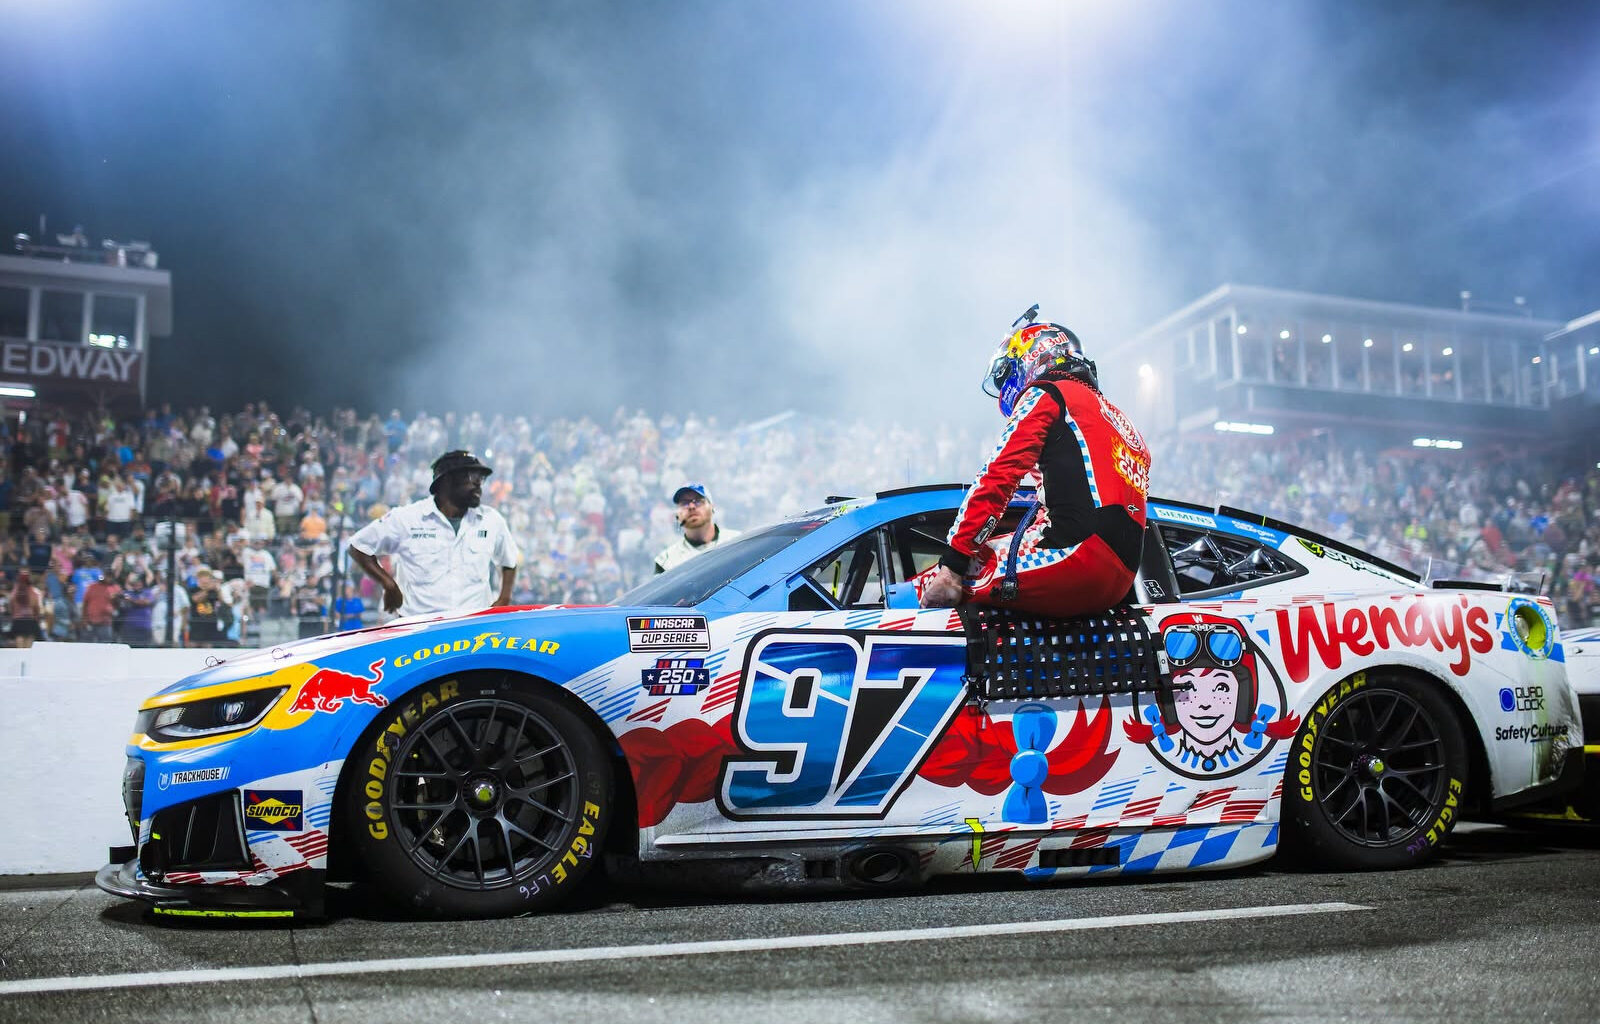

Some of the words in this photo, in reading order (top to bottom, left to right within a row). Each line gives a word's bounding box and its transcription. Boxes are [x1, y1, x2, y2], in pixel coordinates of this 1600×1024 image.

[1022, 342, 1047, 362] Red
[1119, 447, 1136, 469] LET
[1158, 509, 1213, 525] SIEMENS
[653, 618, 695, 629] NASCAR
[641, 633, 662, 644] CUP
[663, 632, 698, 643] SERIES
[1276, 594, 1493, 683] Wendy's
[658, 669, 695, 684] 250
[1515, 686, 1543, 699] QUAD
[1517, 699, 1545, 711] LOCK
[720, 631, 968, 816] 97
[174, 769, 220, 784] TRACKHOUSE
[247, 806, 300, 817] SUNOCO
[1425, 777, 1462, 847] EAGLE
[551, 800, 600, 884] EAGLE
